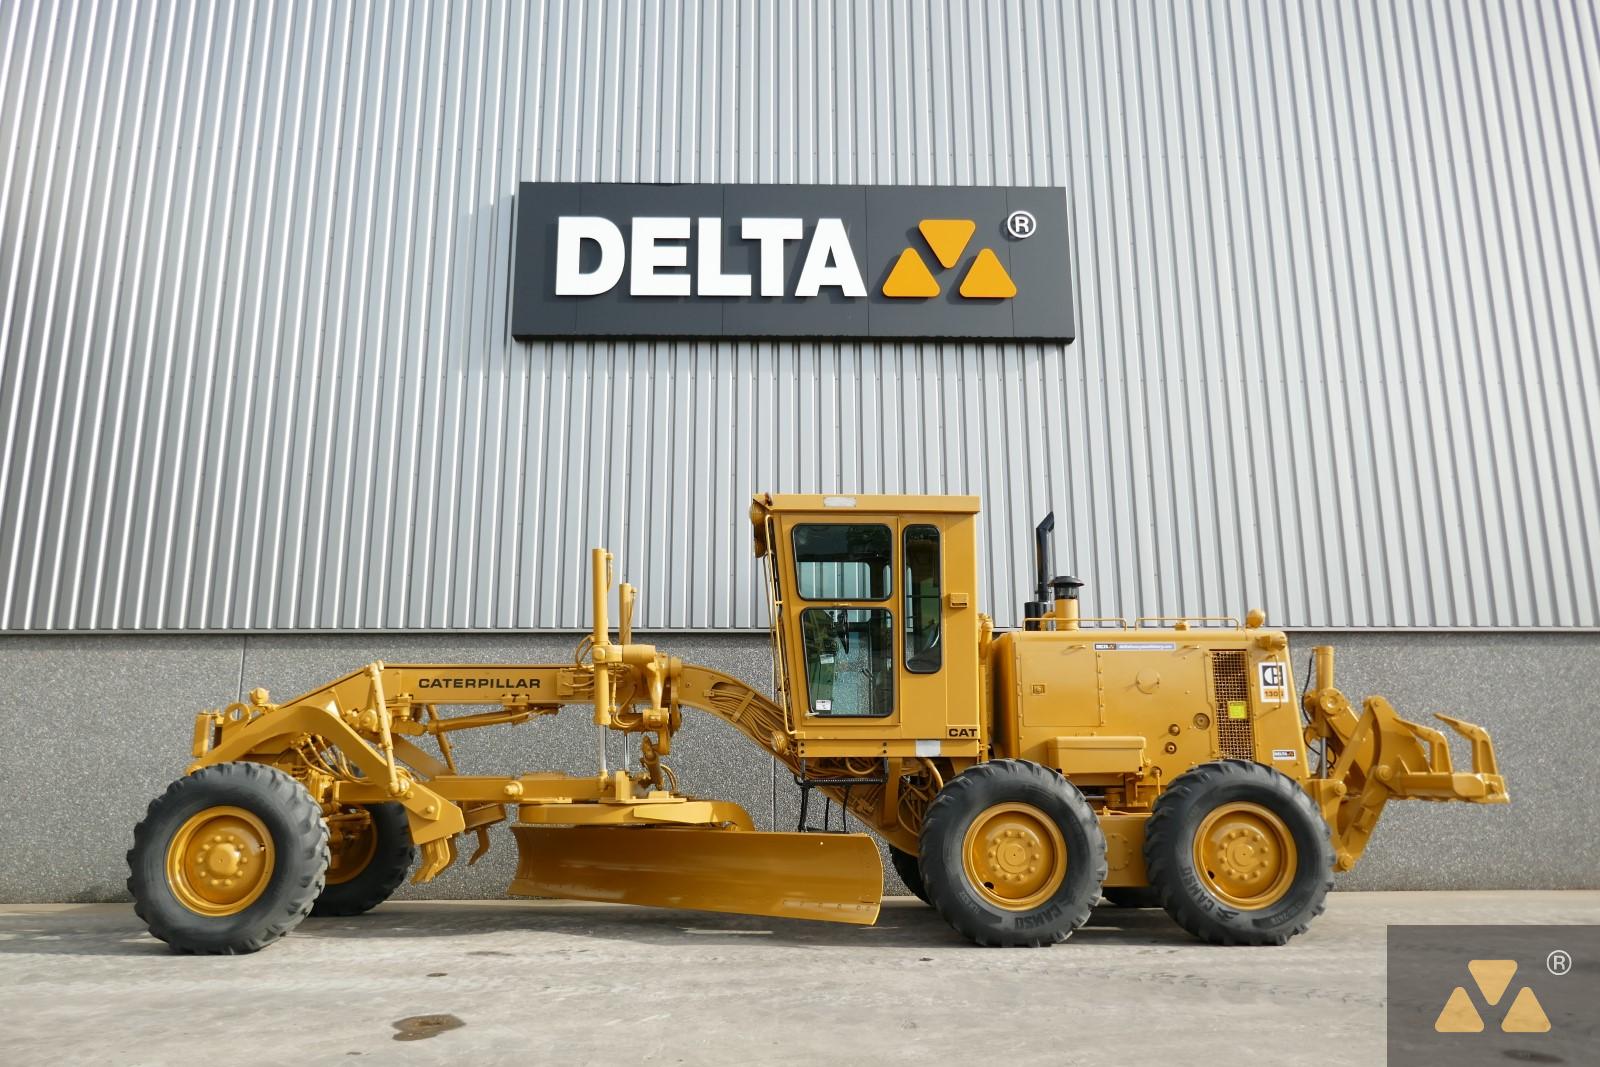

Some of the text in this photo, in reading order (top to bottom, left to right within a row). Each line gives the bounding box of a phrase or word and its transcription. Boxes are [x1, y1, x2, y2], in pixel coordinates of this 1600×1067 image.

[555, 216, 867, 297] DELTA
[418, 678, 541, 689] CATERPILLAR
[948, 728, 978, 737] CAT
[1181, 865, 1215, 913] CAMSO
